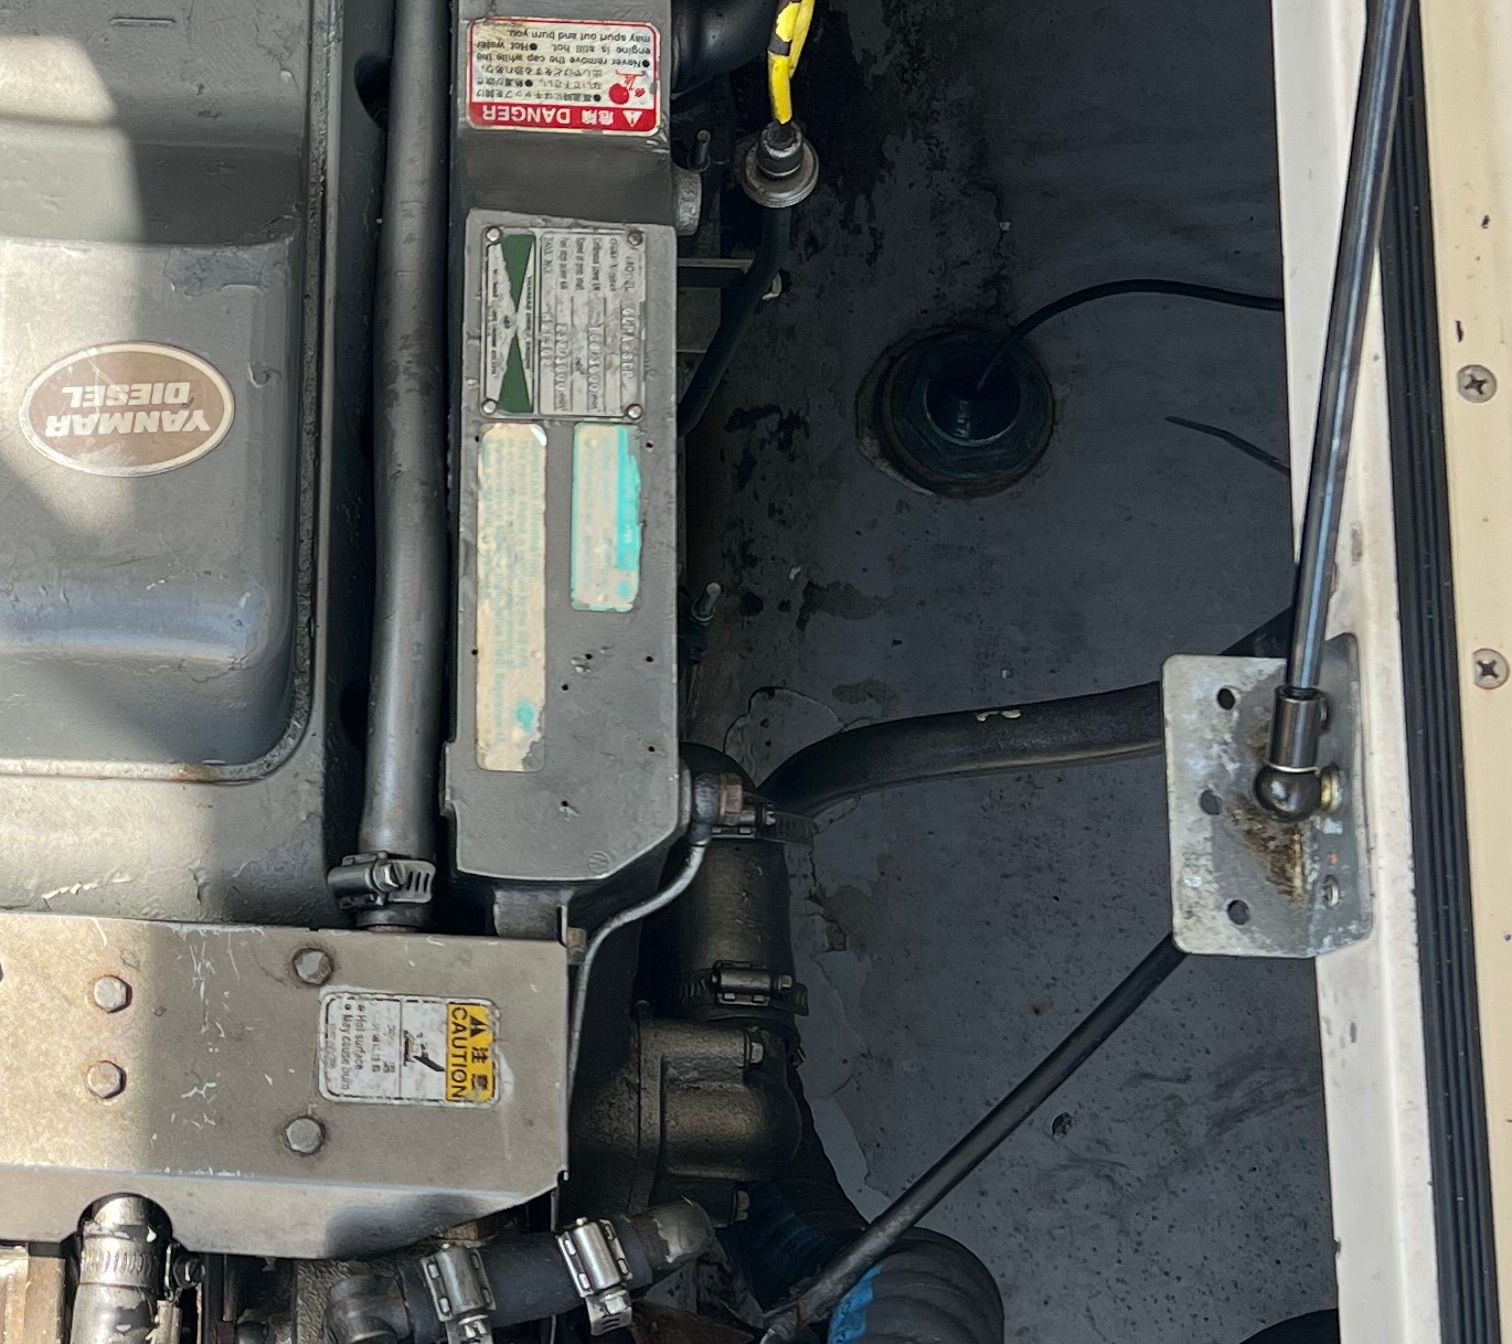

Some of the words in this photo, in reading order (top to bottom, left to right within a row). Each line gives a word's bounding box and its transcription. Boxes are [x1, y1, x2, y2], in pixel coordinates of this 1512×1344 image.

[532, 31, 555, 39] burn
[559, 32, 577, 40] and
[580, 33, 597, 41] out
[600, 33, 626, 43] spurt
[630, 34, 650, 44] may
[477, 41, 504, 49] water
[511, 42, 528, 50] Hot
[576, 45, 595, 53] still
[616, 44, 650, 54] engine
[601, 46, 610, 54] is
[477, 53, 493, 61] the
[496, 54, 523, 62] while
[550, 56, 566, 64] the
[570, 56, 607, 64] remove
[612, 59, 641, 67] Never
[482, 105, 571, 124] DANGER
[61, 382, 191, 408] DIESEL
[45, 409, 211, 437] YANMAR
[340, 1014, 351, 1032] May
[356, 1015, 365, 1032] Hot
[341, 1036, 351, 1065] cause
[354, 1035, 365, 1070] surface
[452, 1007, 467, 1098] CAUTION
